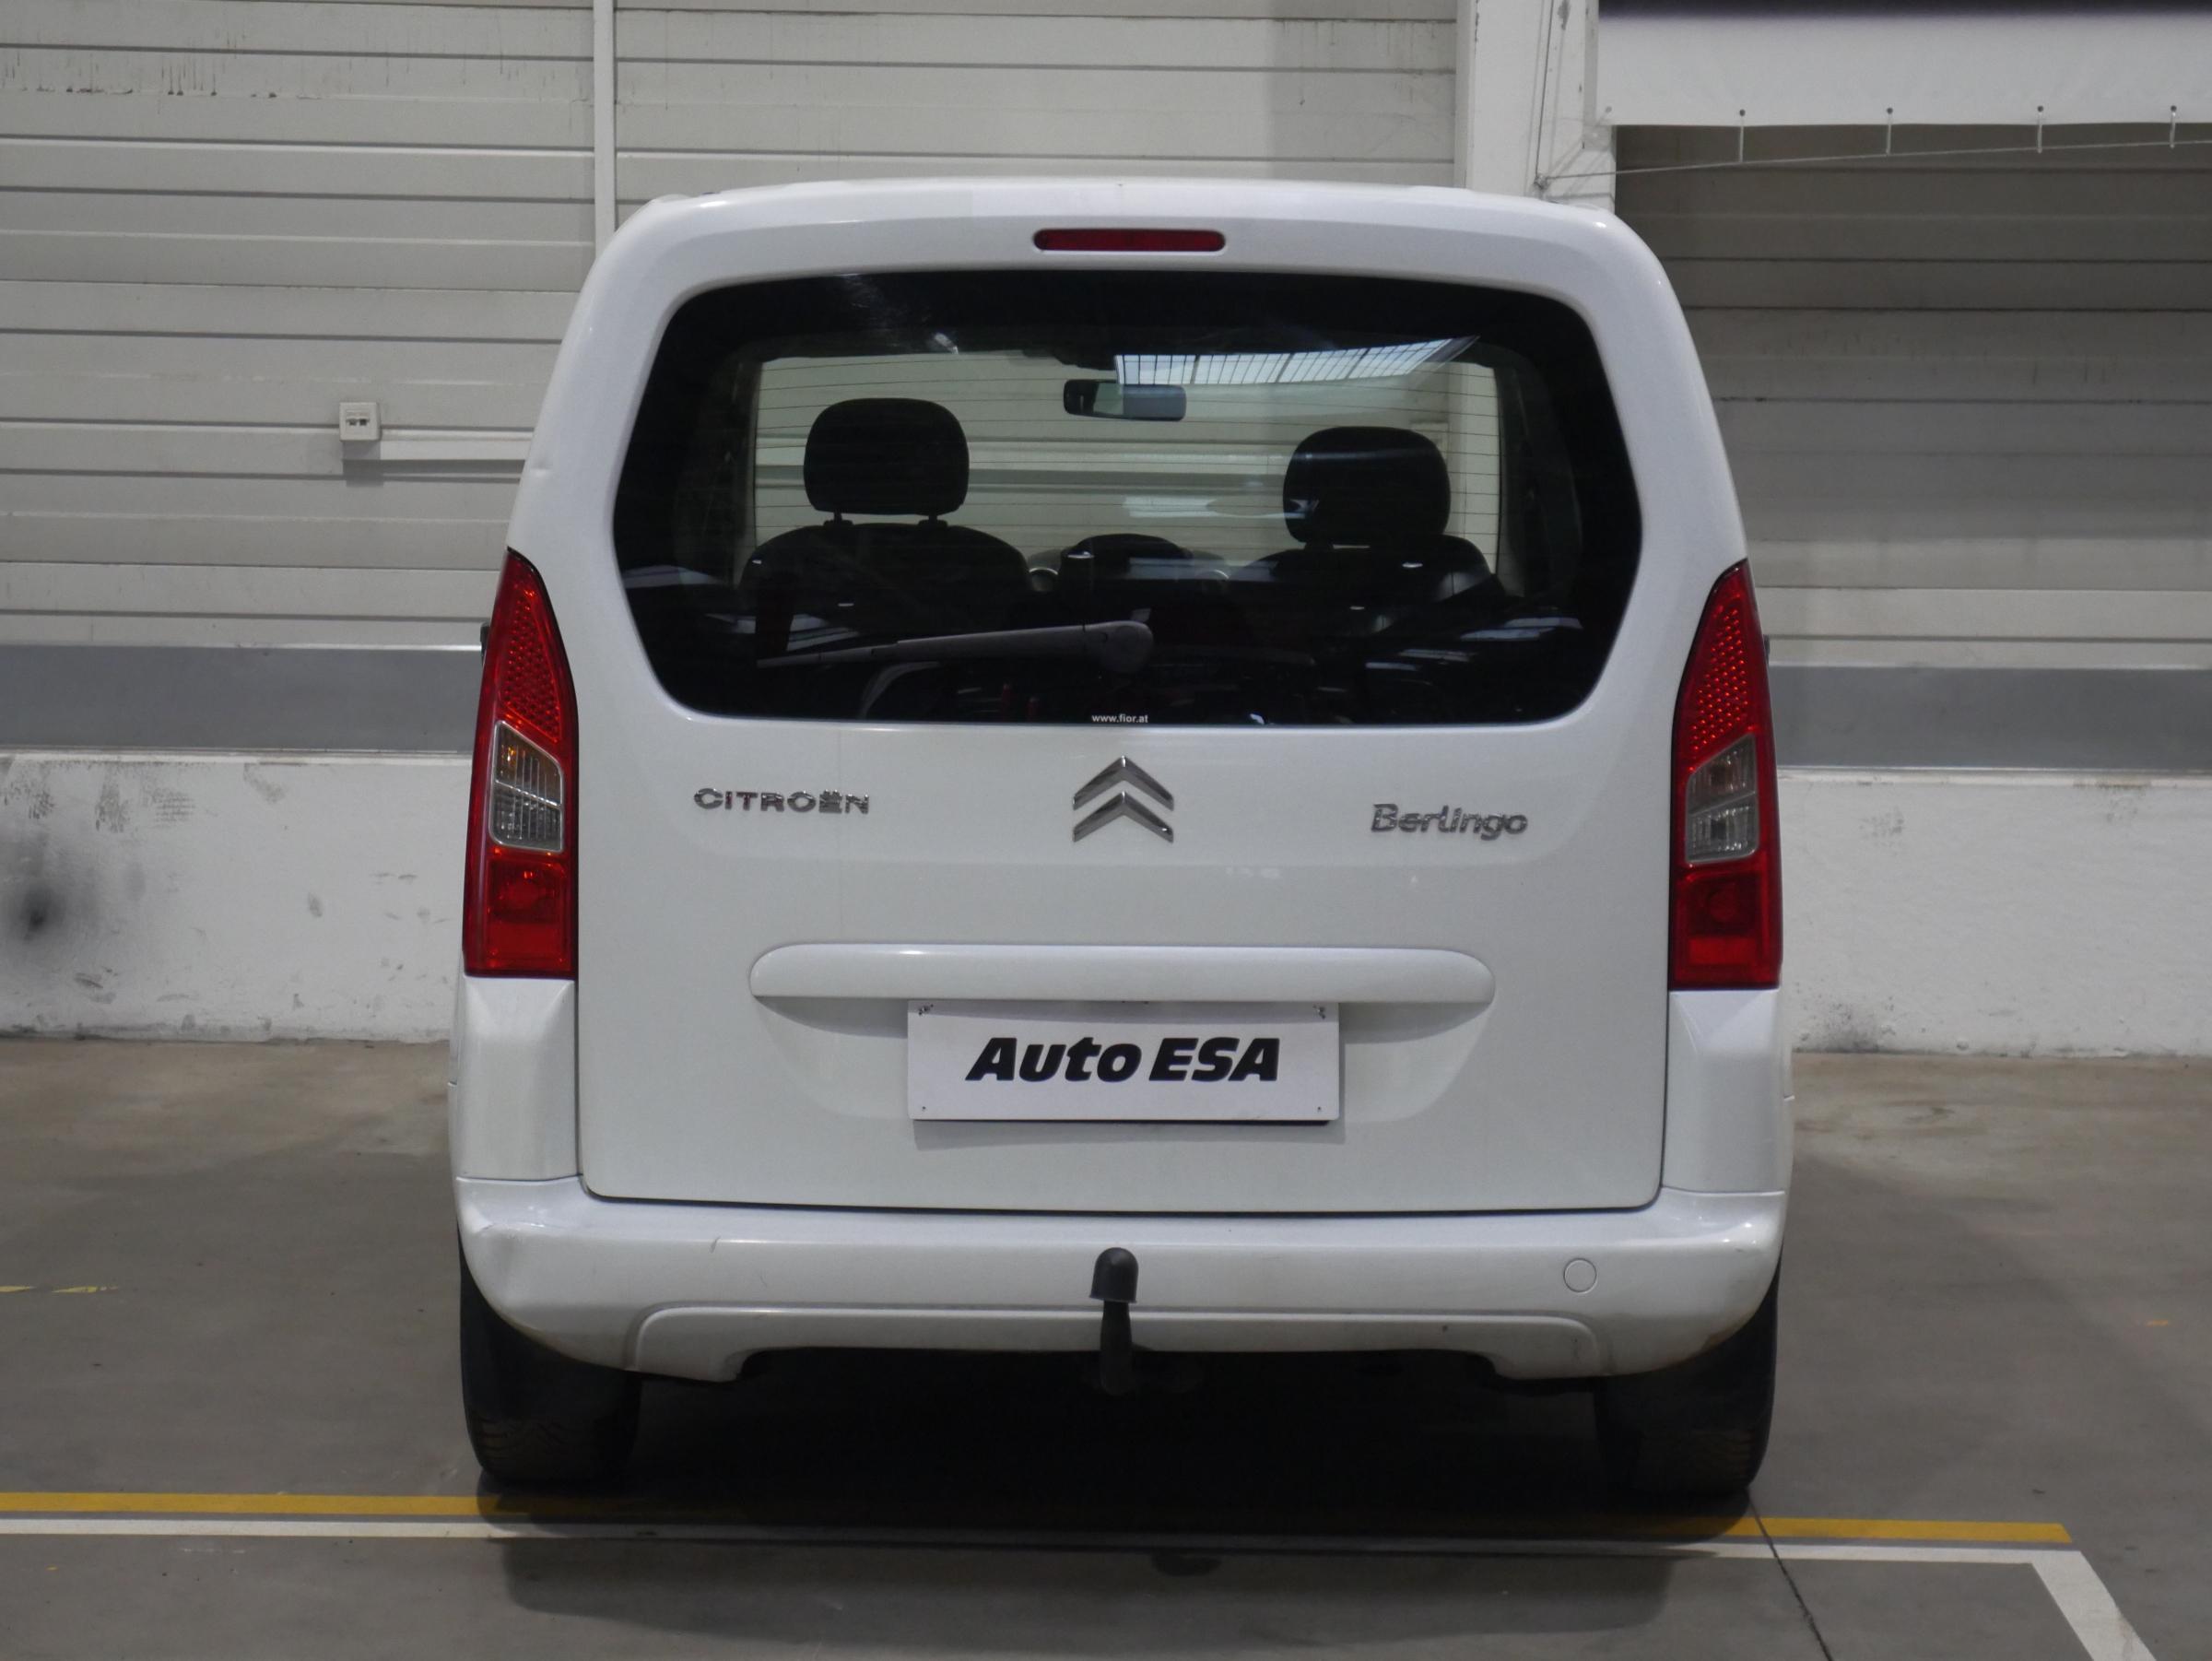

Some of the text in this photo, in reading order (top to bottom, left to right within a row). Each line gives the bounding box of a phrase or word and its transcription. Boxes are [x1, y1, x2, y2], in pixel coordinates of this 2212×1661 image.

[1091, 713, 1148, 724] www.fior.at
[693, 787, 870, 815] CITROËN
[1371, 803, 1529, 842] Berlingo
[964, 1036, 1280, 1083] Auto ESA
